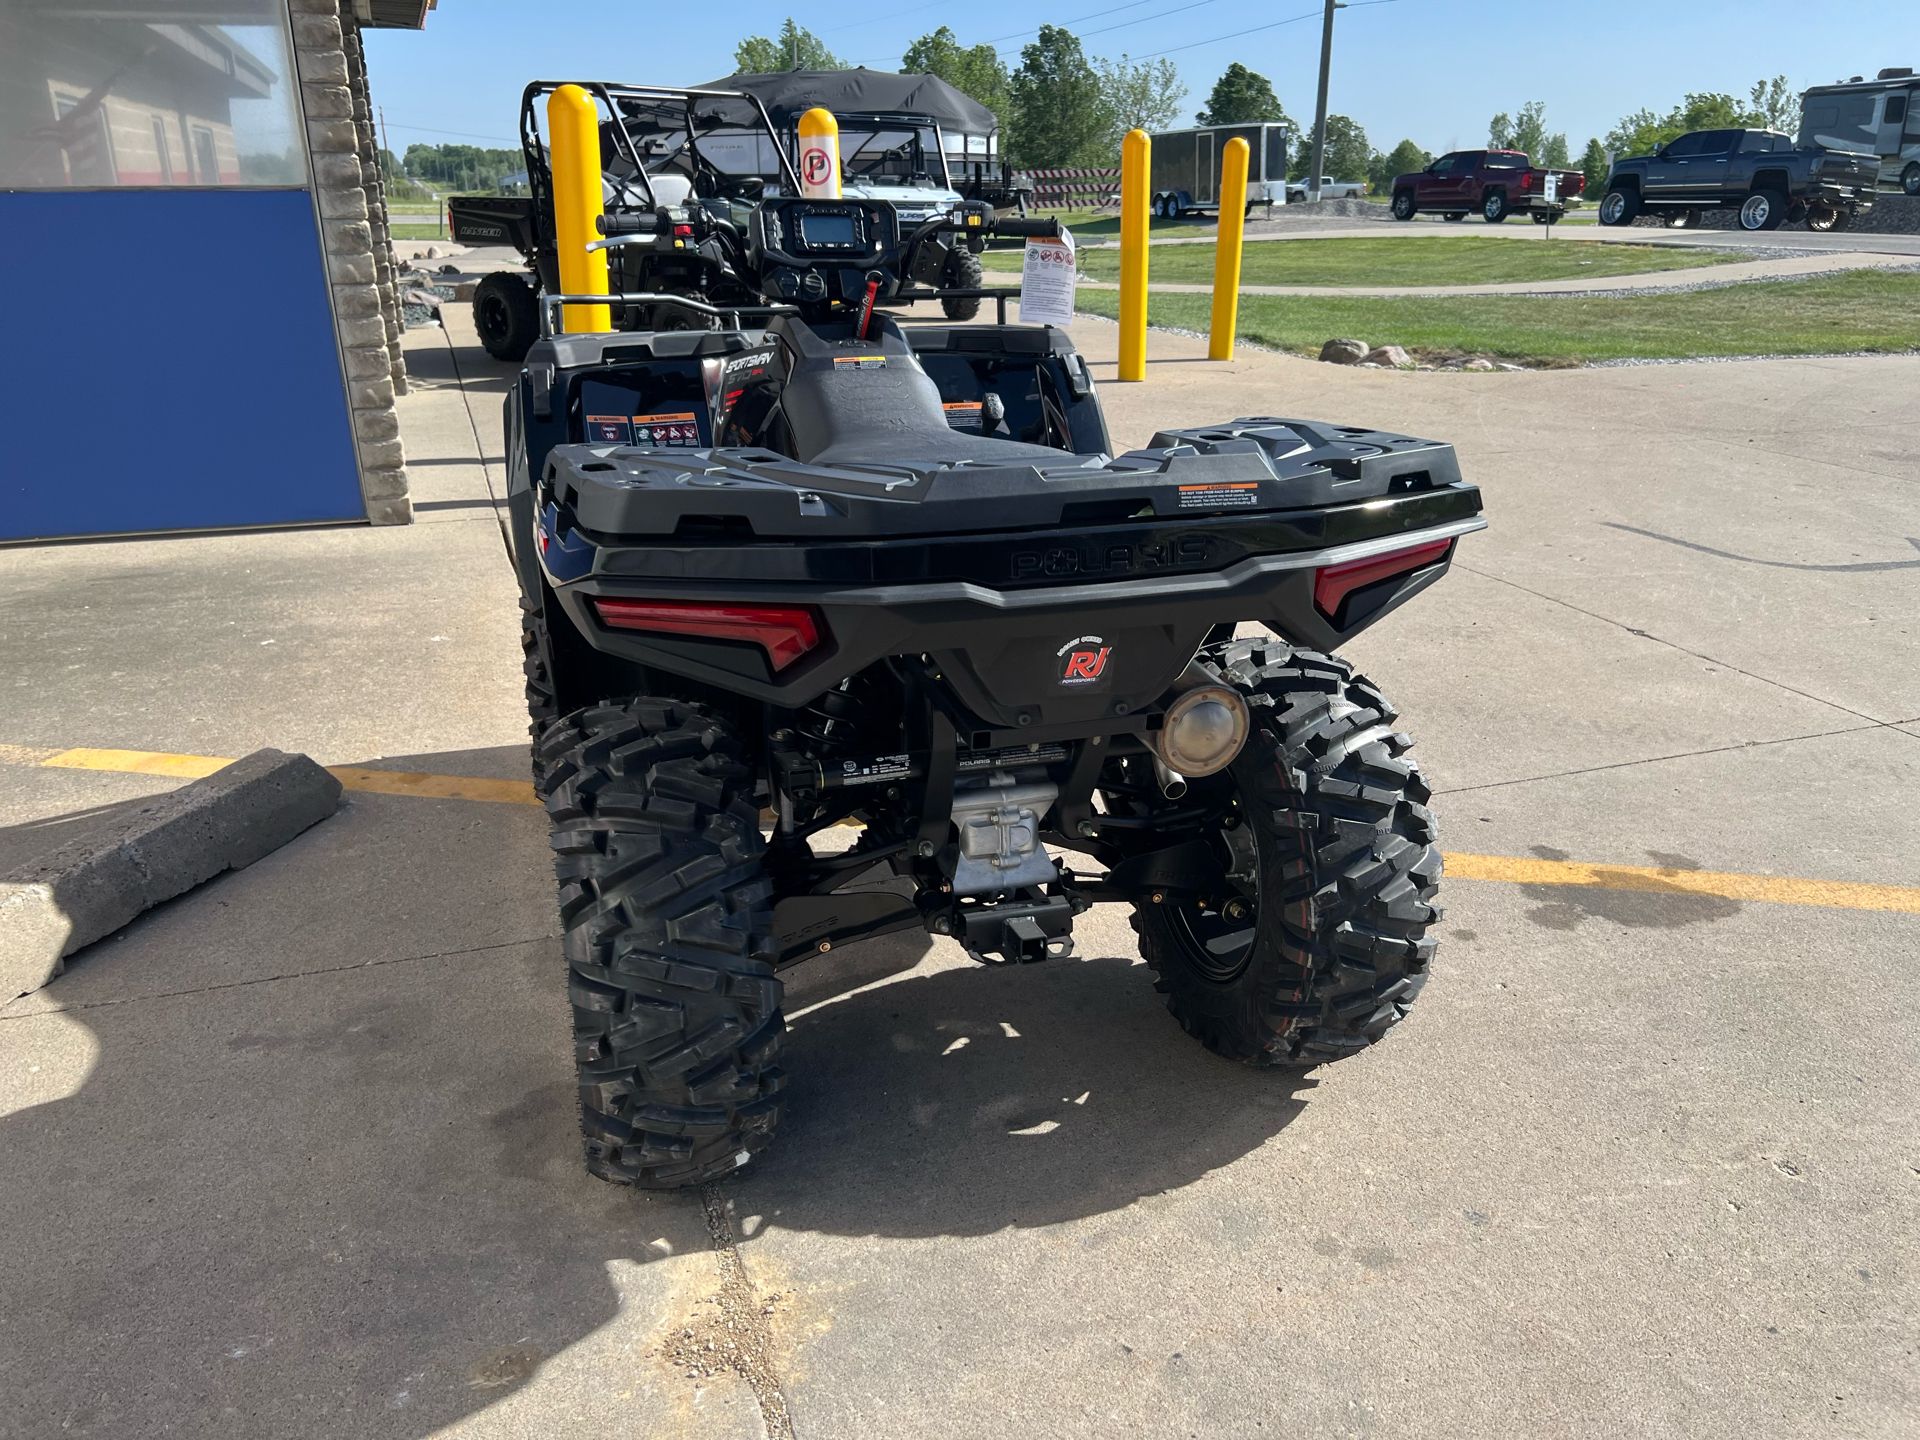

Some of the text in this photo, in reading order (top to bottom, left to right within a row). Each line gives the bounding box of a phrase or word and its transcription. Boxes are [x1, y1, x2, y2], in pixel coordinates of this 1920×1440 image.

[897, 212, 927, 220] OLARIS
[460, 226, 502, 237] RANGER
[725, 351, 775, 374] SPORTSMAN
[1010, 536, 1208, 579] POLARIS
[1064, 647, 1112, 678] RJ
[959, 759, 991, 767] POLARIS
